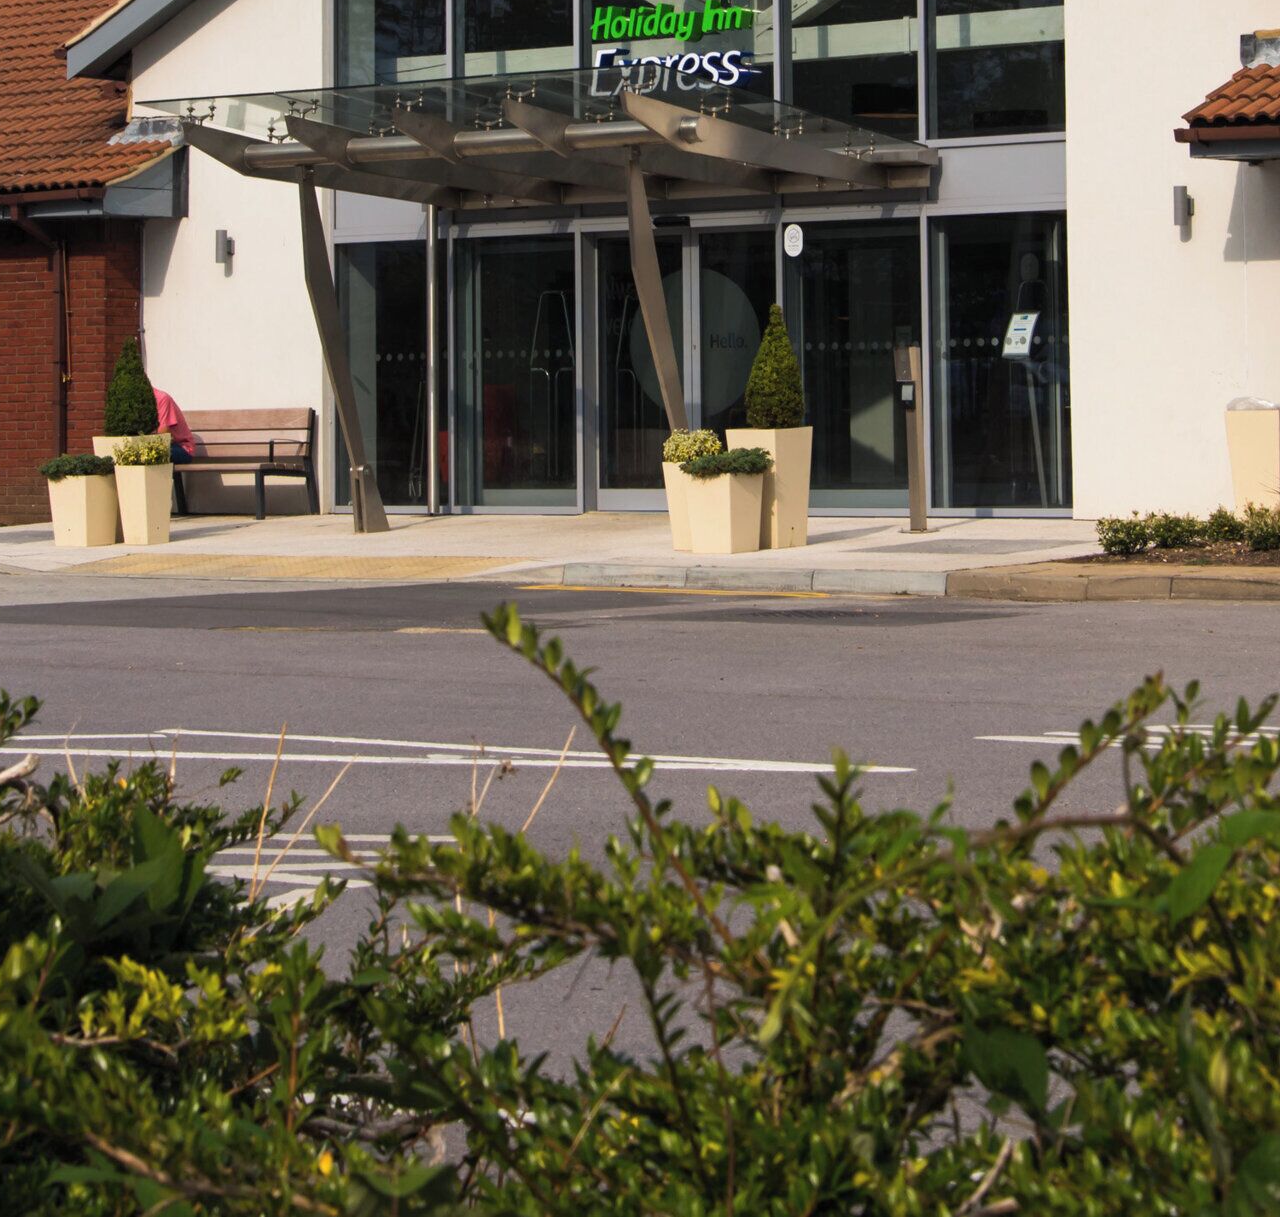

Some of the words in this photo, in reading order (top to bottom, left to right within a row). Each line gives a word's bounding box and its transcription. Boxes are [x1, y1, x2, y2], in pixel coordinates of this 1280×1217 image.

[590, 2, 696, 42] Holiday
[701, 0, 742, 32] Inn
[590, 48, 741, 97] Express
[710, 334, 748, 349] Hello.
